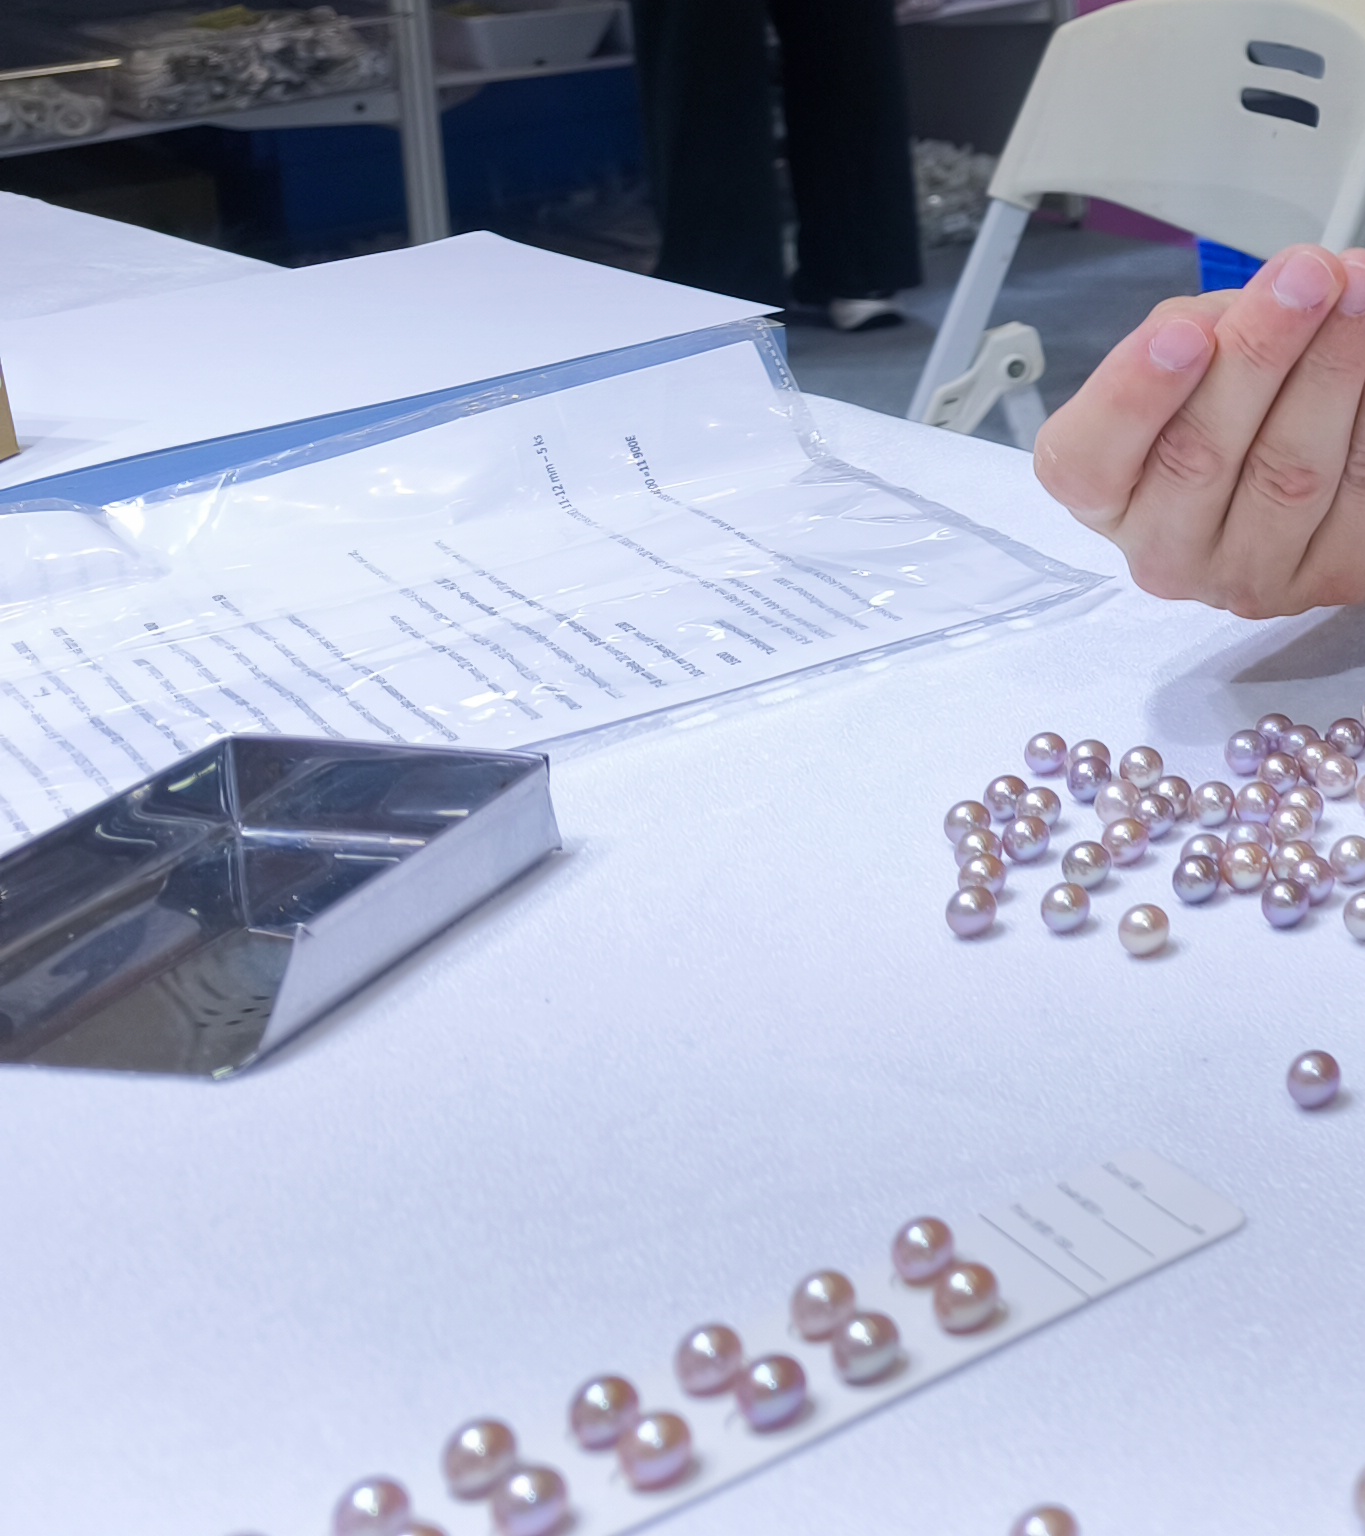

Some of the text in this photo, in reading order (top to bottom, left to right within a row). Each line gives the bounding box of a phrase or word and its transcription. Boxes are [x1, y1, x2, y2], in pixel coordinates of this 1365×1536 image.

[532, 434, 545, 447] ks
[546, 464, 560, 482] mm
[552, 482, 572, 511] 11-12
